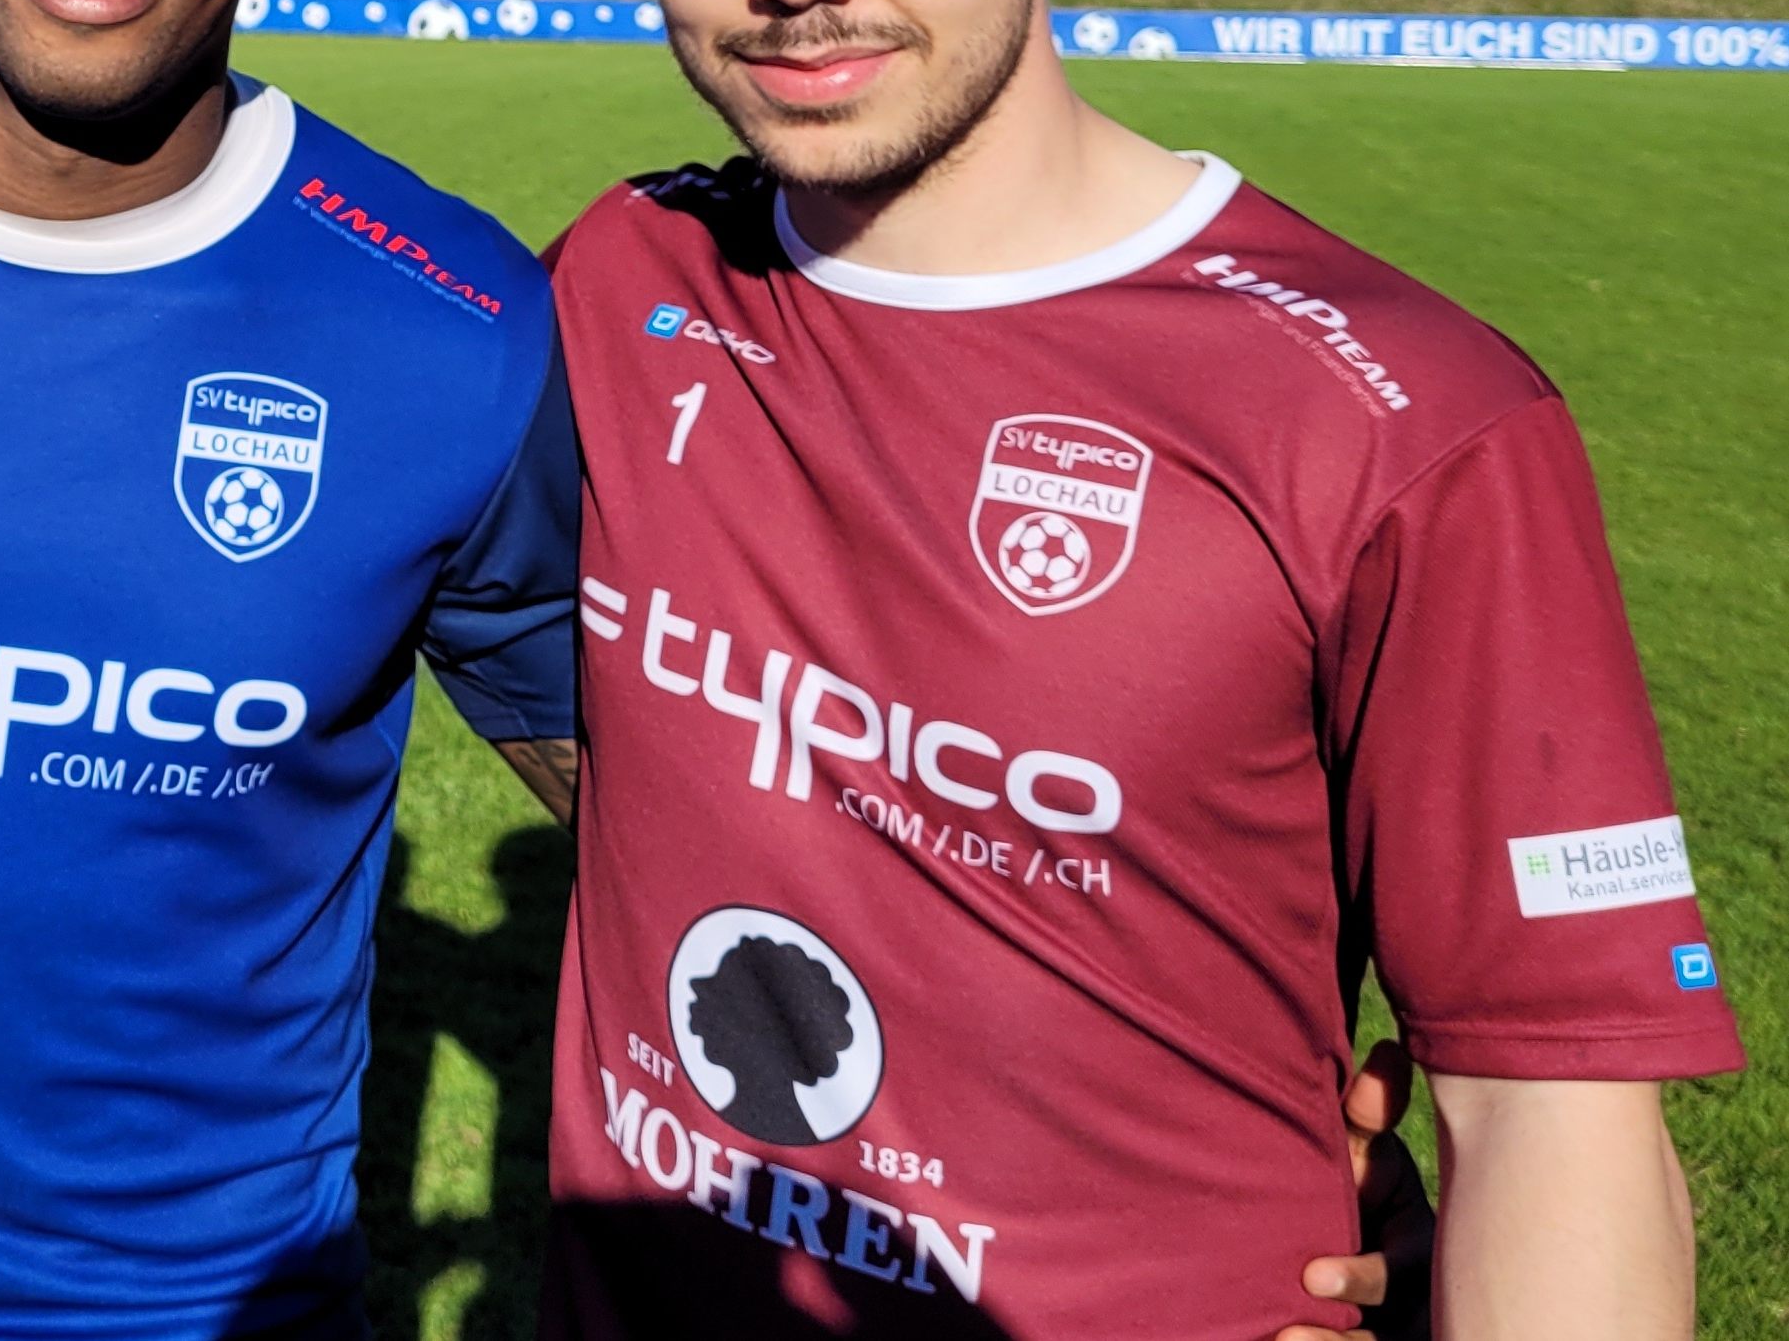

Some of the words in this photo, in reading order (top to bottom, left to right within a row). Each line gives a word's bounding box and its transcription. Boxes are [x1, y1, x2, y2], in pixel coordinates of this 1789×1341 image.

[1212, 15, 1304, 54] WIR
[1311, 18, 1394, 57] MIT
[1400, 19, 1534, 59] EUCH
[1541, 21, 1659, 64] SIND
[1667, 25, 1789, 68] 100%
[193, 431, 311, 464] LOCHAU
[666, 381, 707, 466] 1
[993, 471, 1127, 515] LOCHAU
[642, 587, 1123, 835] typico
[627, 1032, 676, 1087] SEIT
[599, 1065, 996, 1305] MOHREN
[859, 1139, 945, 1189] 1834
